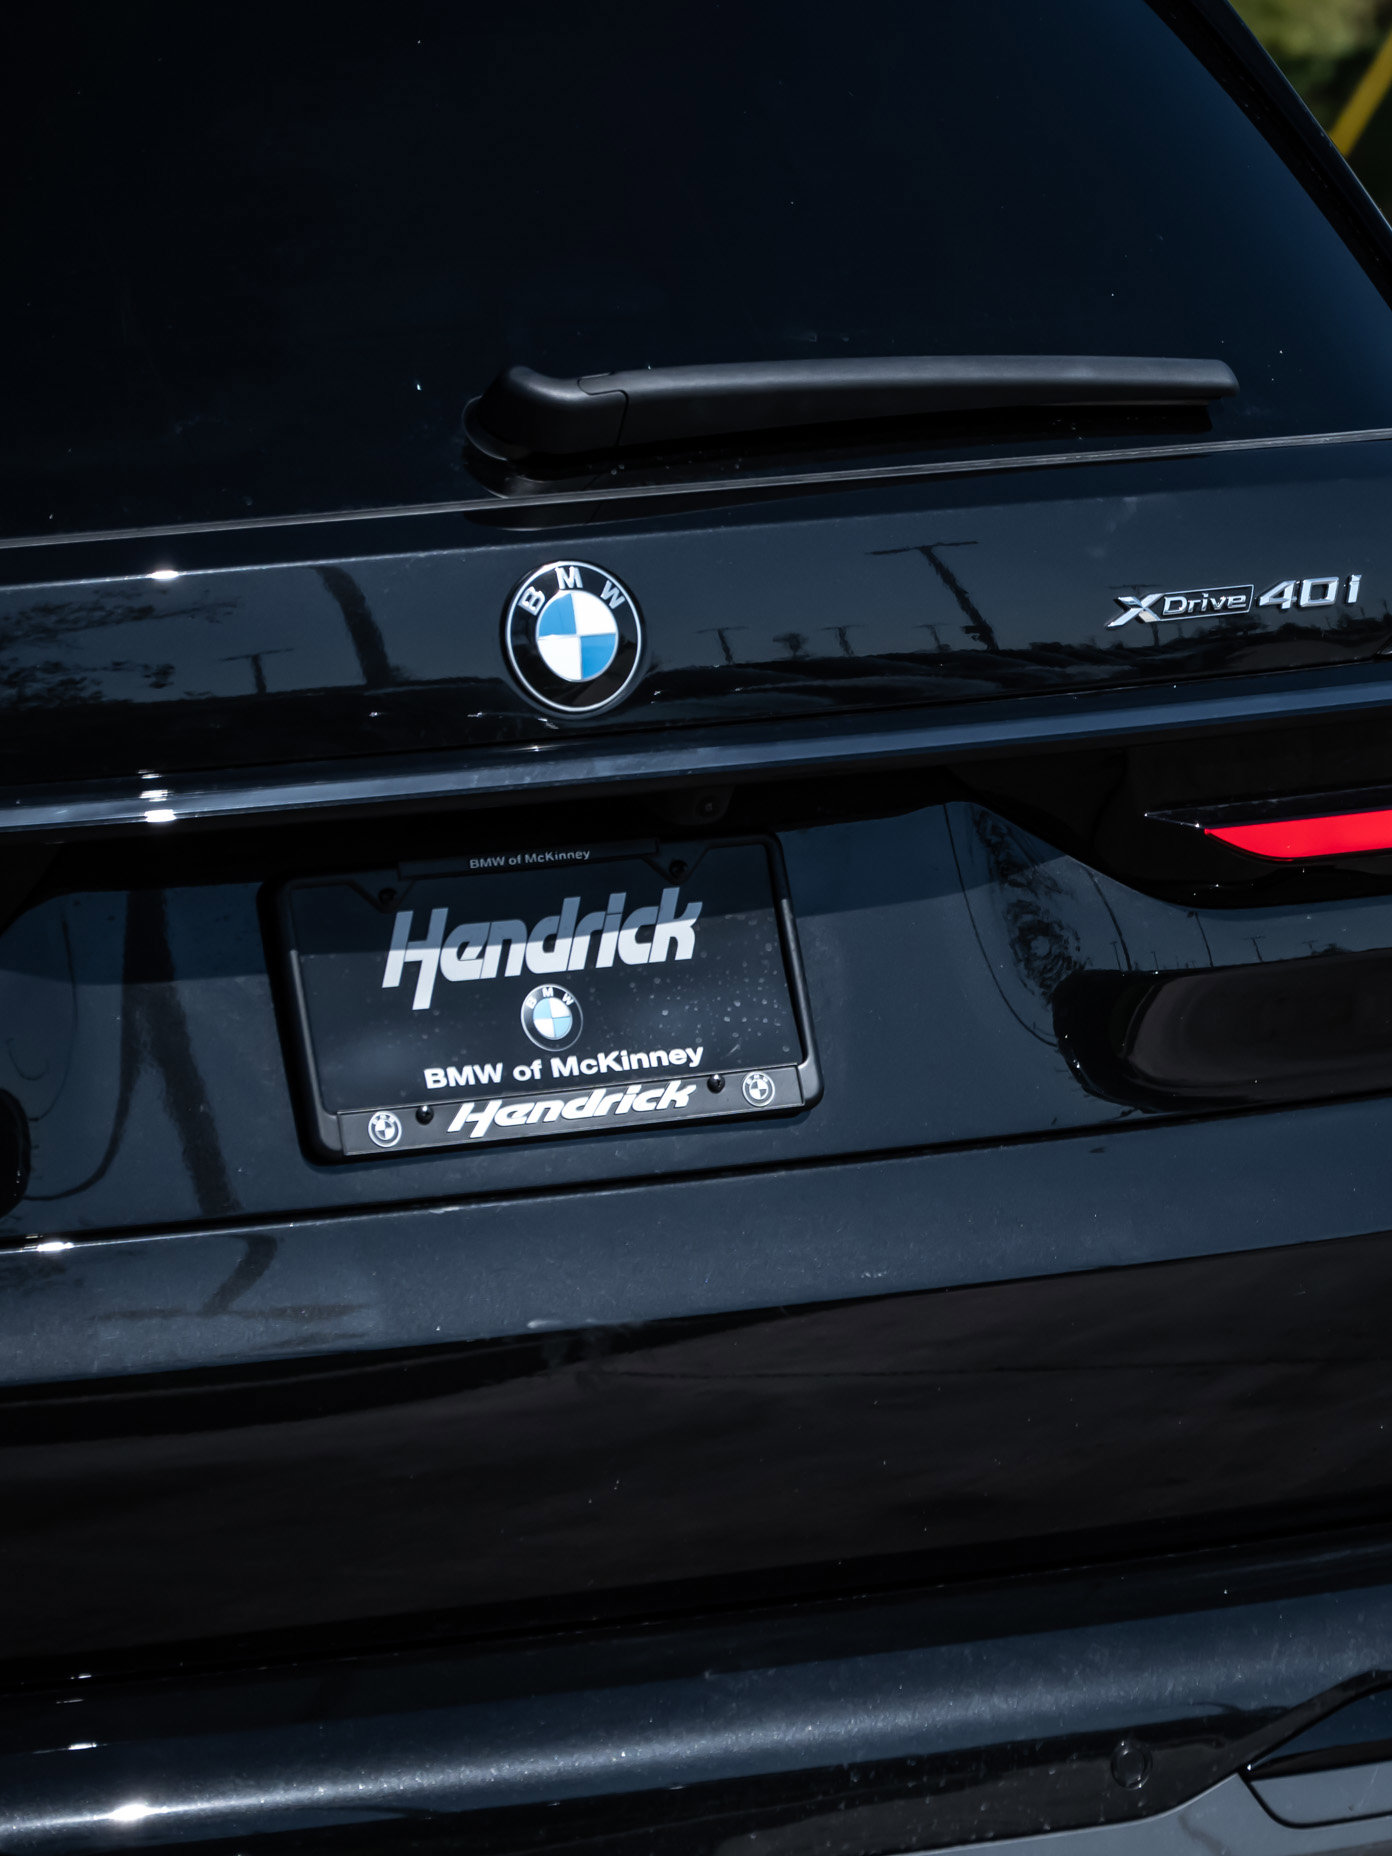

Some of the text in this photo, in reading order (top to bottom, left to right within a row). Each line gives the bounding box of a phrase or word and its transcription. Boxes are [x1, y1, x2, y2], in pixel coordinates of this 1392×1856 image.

[518, 566, 625, 616] BMW
[470, 850, 590, 869] BMW of McKinney
[381, 887, 703, 1010] Hendrick
[525, 987, 575, 1010] BMW
[424, 1046, 704, 1090] BMW of McKinney
[447, 1080, 697, 1139] Hendrick
